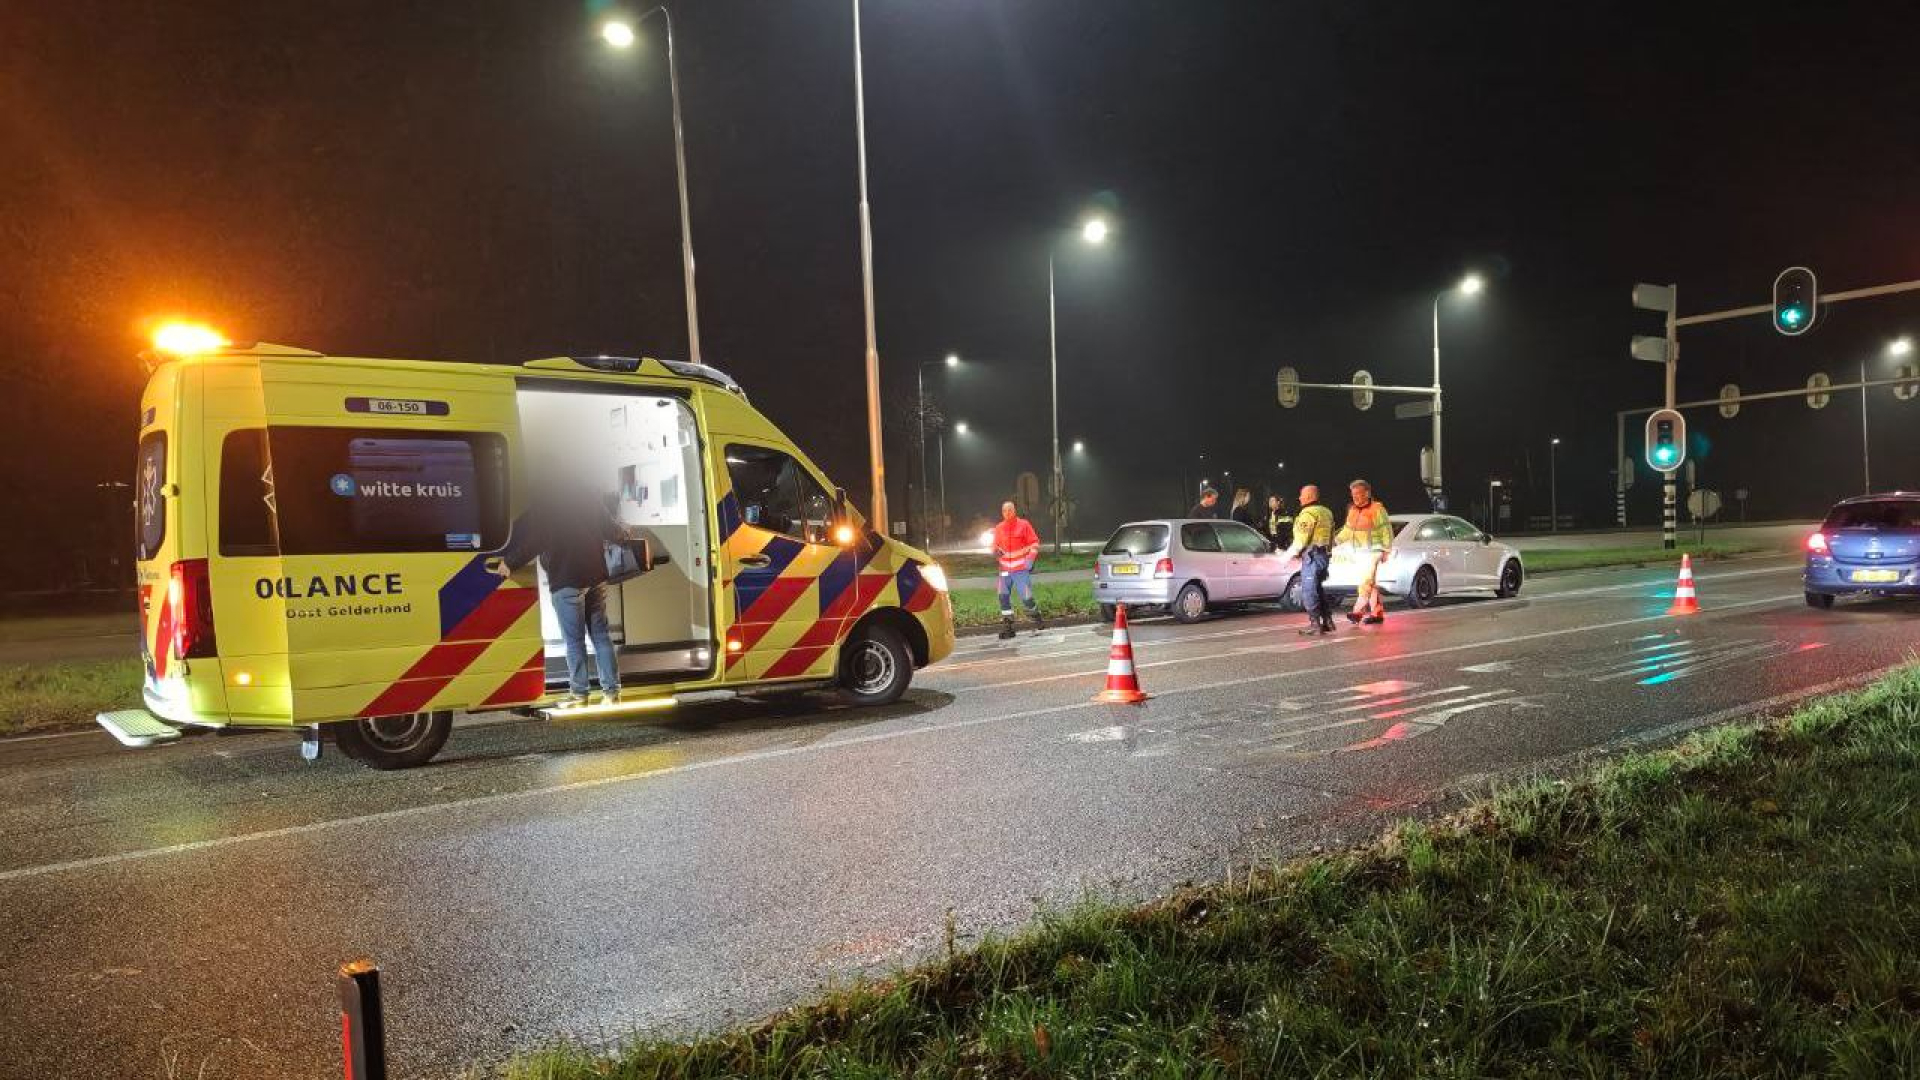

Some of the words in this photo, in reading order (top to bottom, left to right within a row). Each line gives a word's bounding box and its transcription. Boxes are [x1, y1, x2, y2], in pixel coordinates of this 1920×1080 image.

[377, 401, 419, 412] 06-150
[360, 480, 412, 497] witte
[416, 482, 463, 497] kruis
[286, 608, 322, 619] Oost
[328, 603, 412, 616] Gelderland
